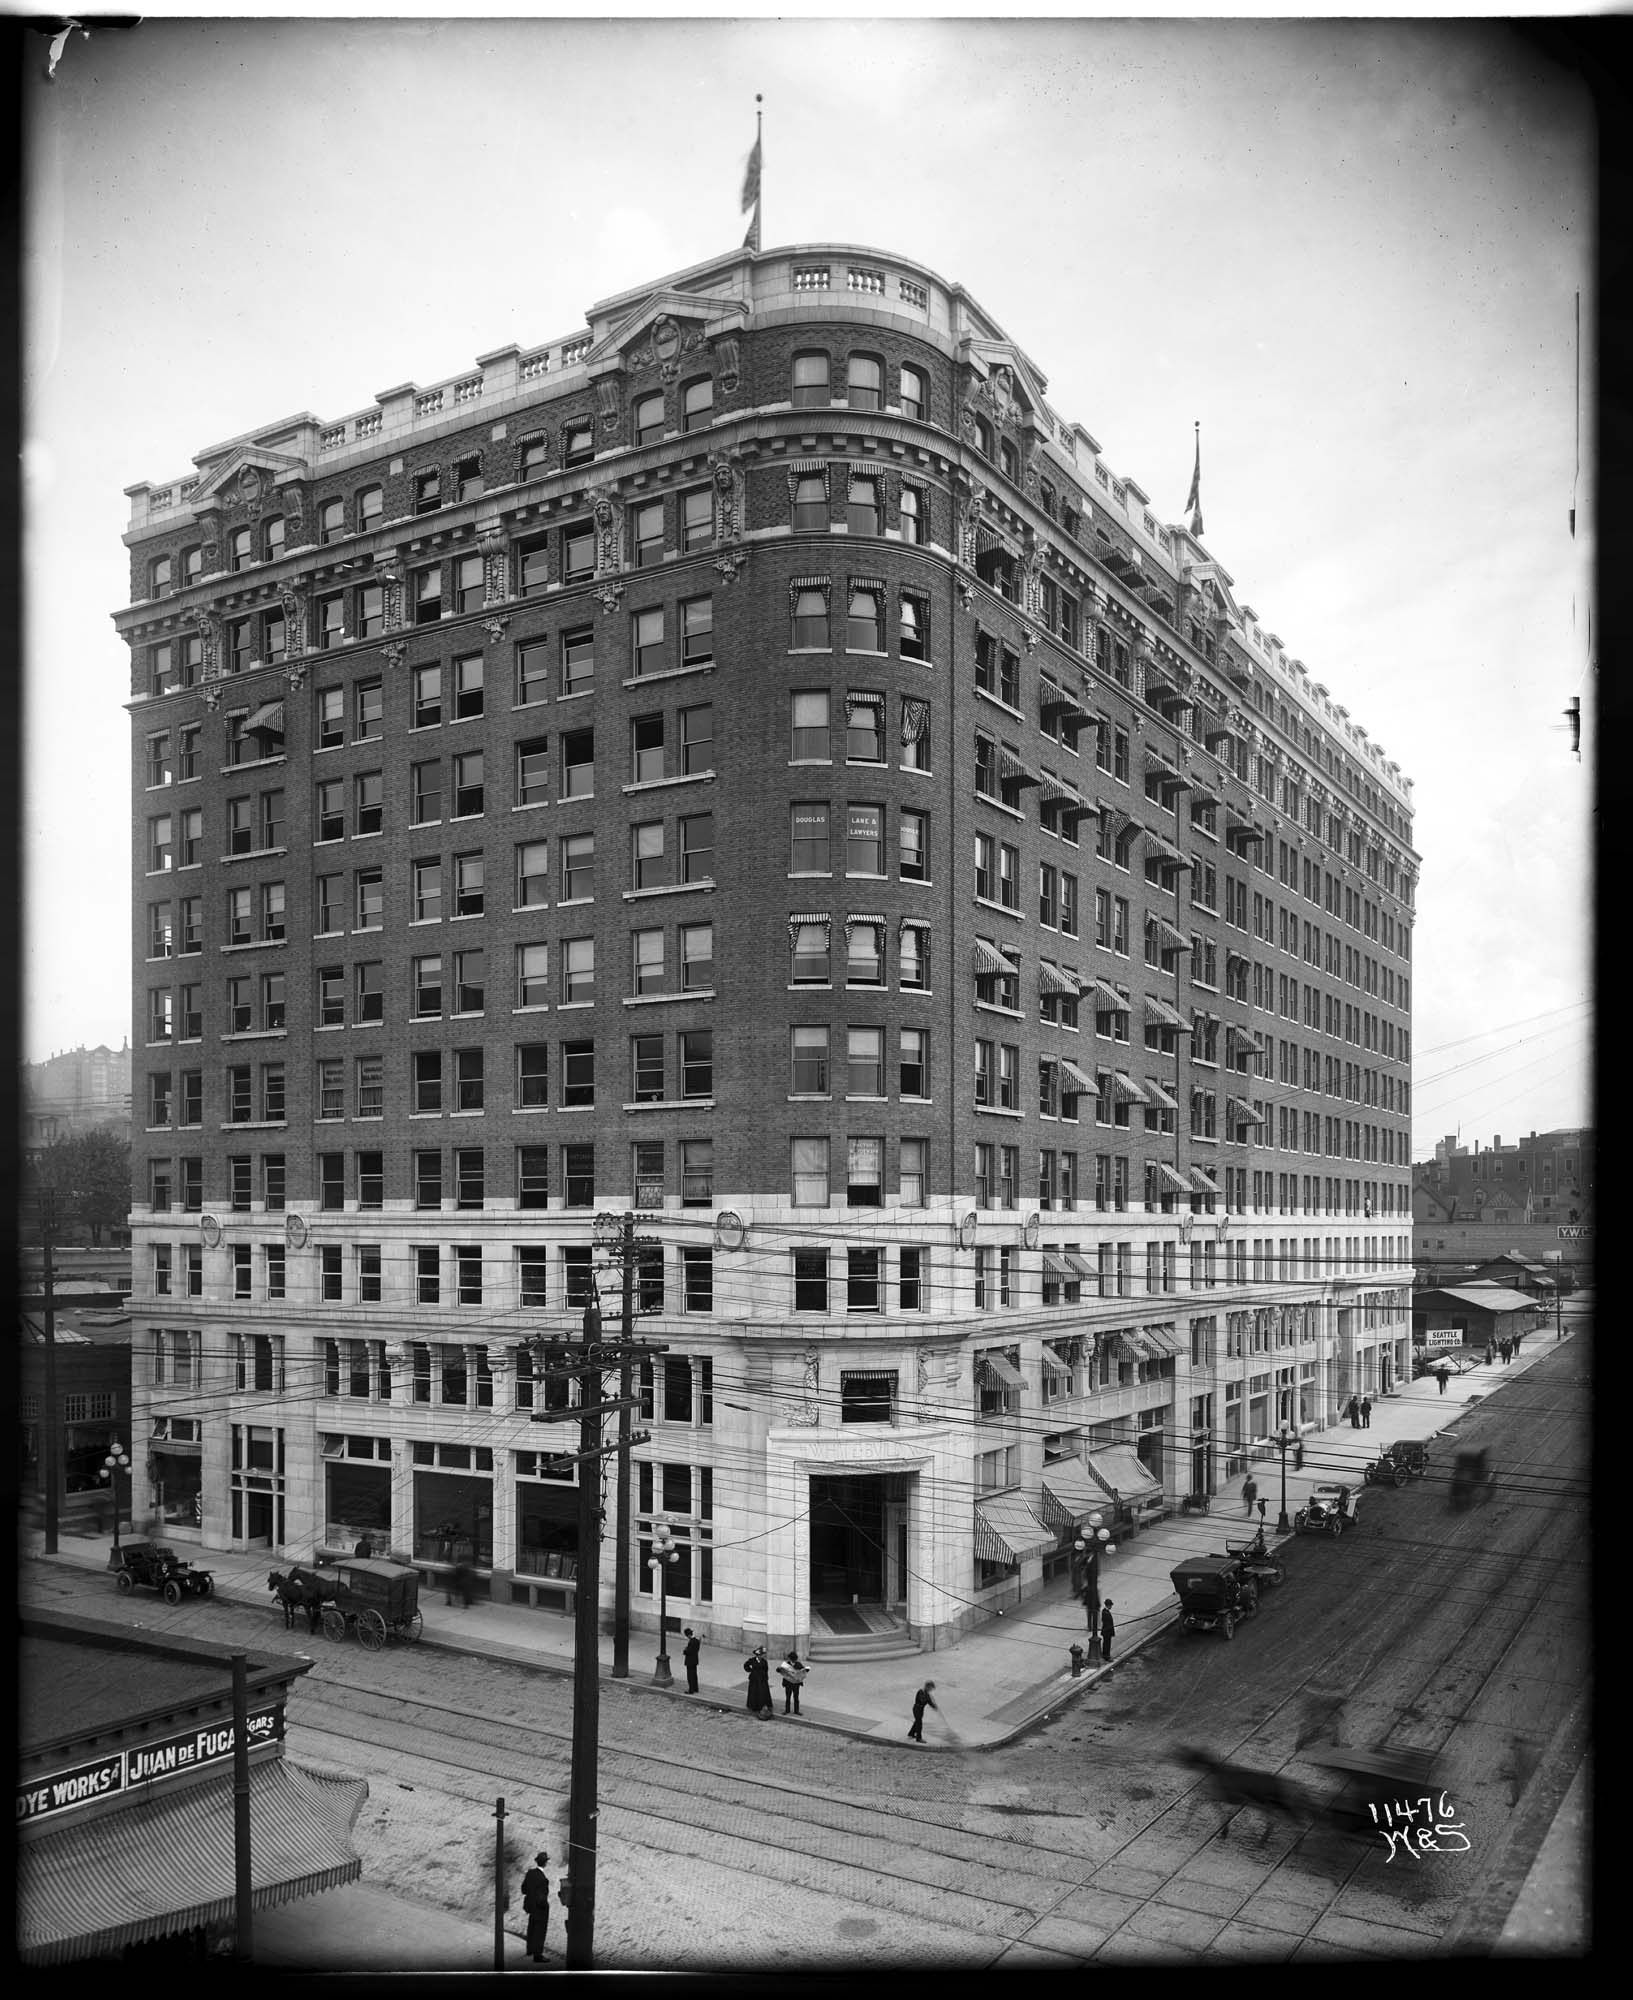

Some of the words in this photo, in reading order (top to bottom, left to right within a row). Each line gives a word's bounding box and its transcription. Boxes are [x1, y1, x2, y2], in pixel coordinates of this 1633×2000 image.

[796, 816, 825, 824] DOUGLAS
[850, 829, 879, 837] LAWYERS
[1432, 1331, 1458, 1339] SEATTLE
[130, 1745, 176, 1780] JUAN
[179, 1743, 195, 1762] DE
[197, 1727, 235, 1760] FUCA
[16, 1788, 49, 1818] DYE
[53, 1768, 111, 1805] WORKS
